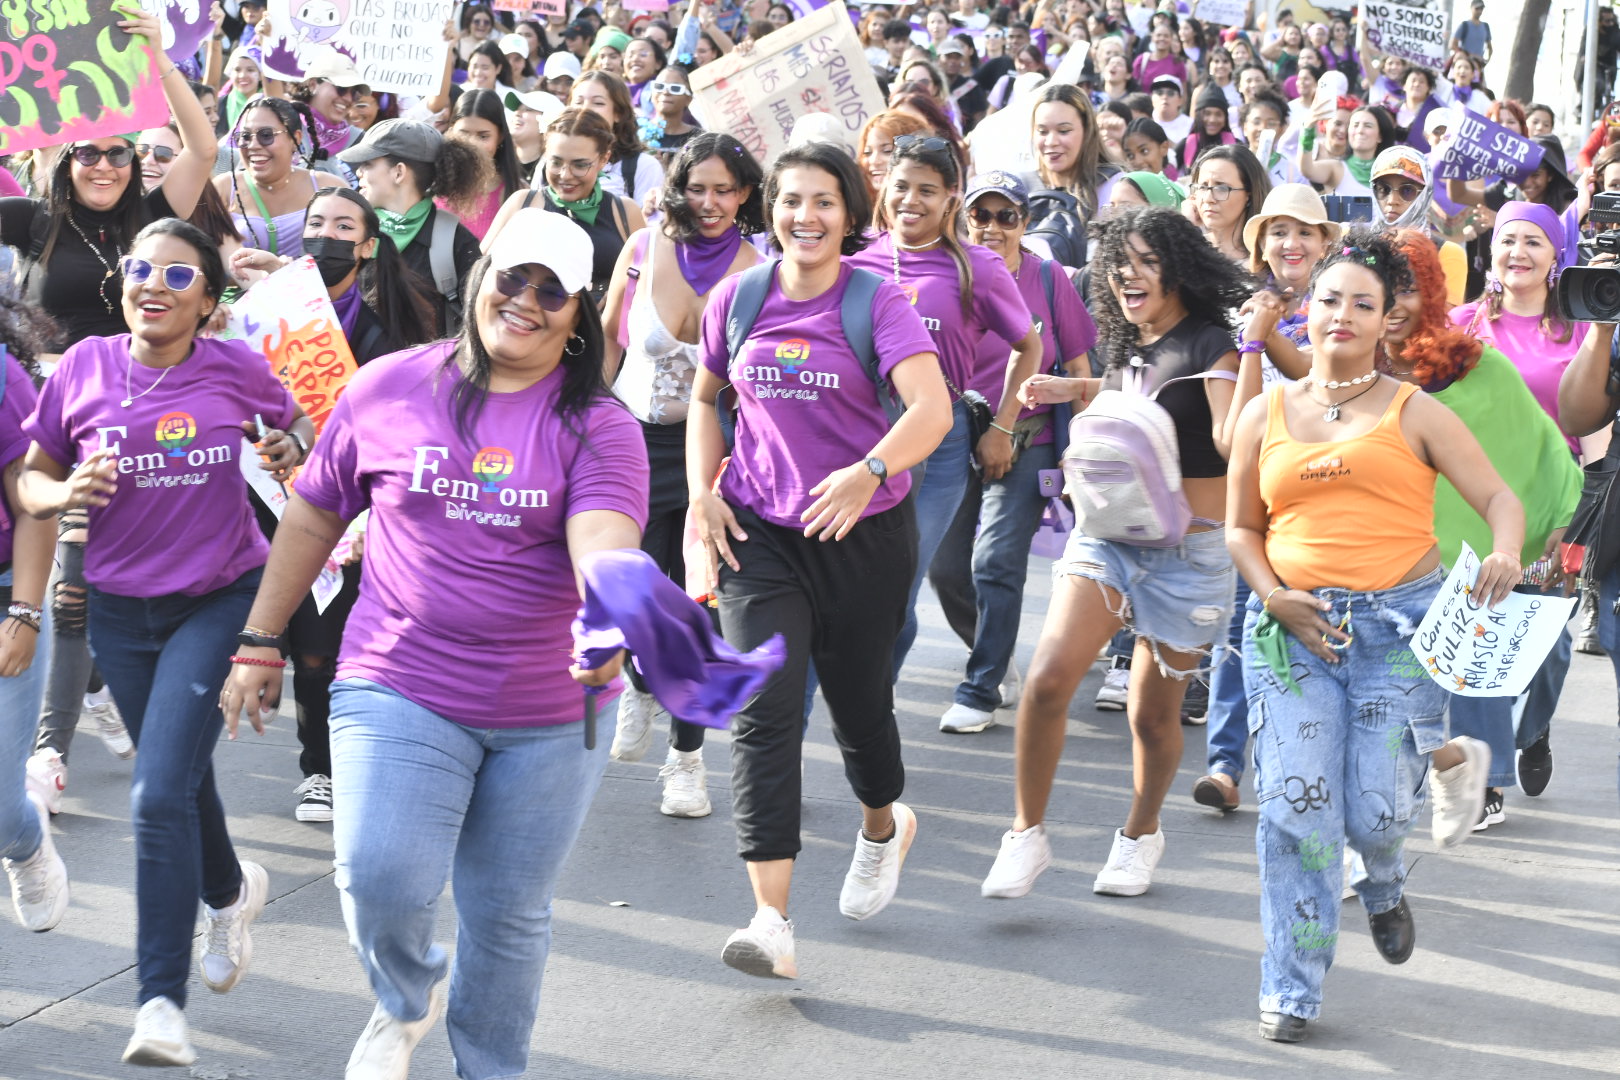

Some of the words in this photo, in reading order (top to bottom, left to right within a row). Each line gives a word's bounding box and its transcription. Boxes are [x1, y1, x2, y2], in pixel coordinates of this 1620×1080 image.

[355, 0, 385, 18] LAS
[393, 1, 450, 23] BRUJAS
[1366, 5, 1390, 18] NO
[1395, 8, 1443, 29] SOMOS
[350, 20, 379, 37] QUE
[391, 23, 413, 39] NO
[1376, 20, 1443, 46] HISTERICAS
[1388, 36, 1424, 54] SOMOS
[1454, 136, 1492, 166] UJER
[1460, 116, 1487, 143] UE
[1490, 132, 1530, 164] SER
[305, 331, 345, 387] POR
[755, 384, 819, 401] Diversas
[134, 472, 210, 488] Diversas
[1300, 468, 1351, 481] DREAM
[445, 500, 522, 527] Diversas
